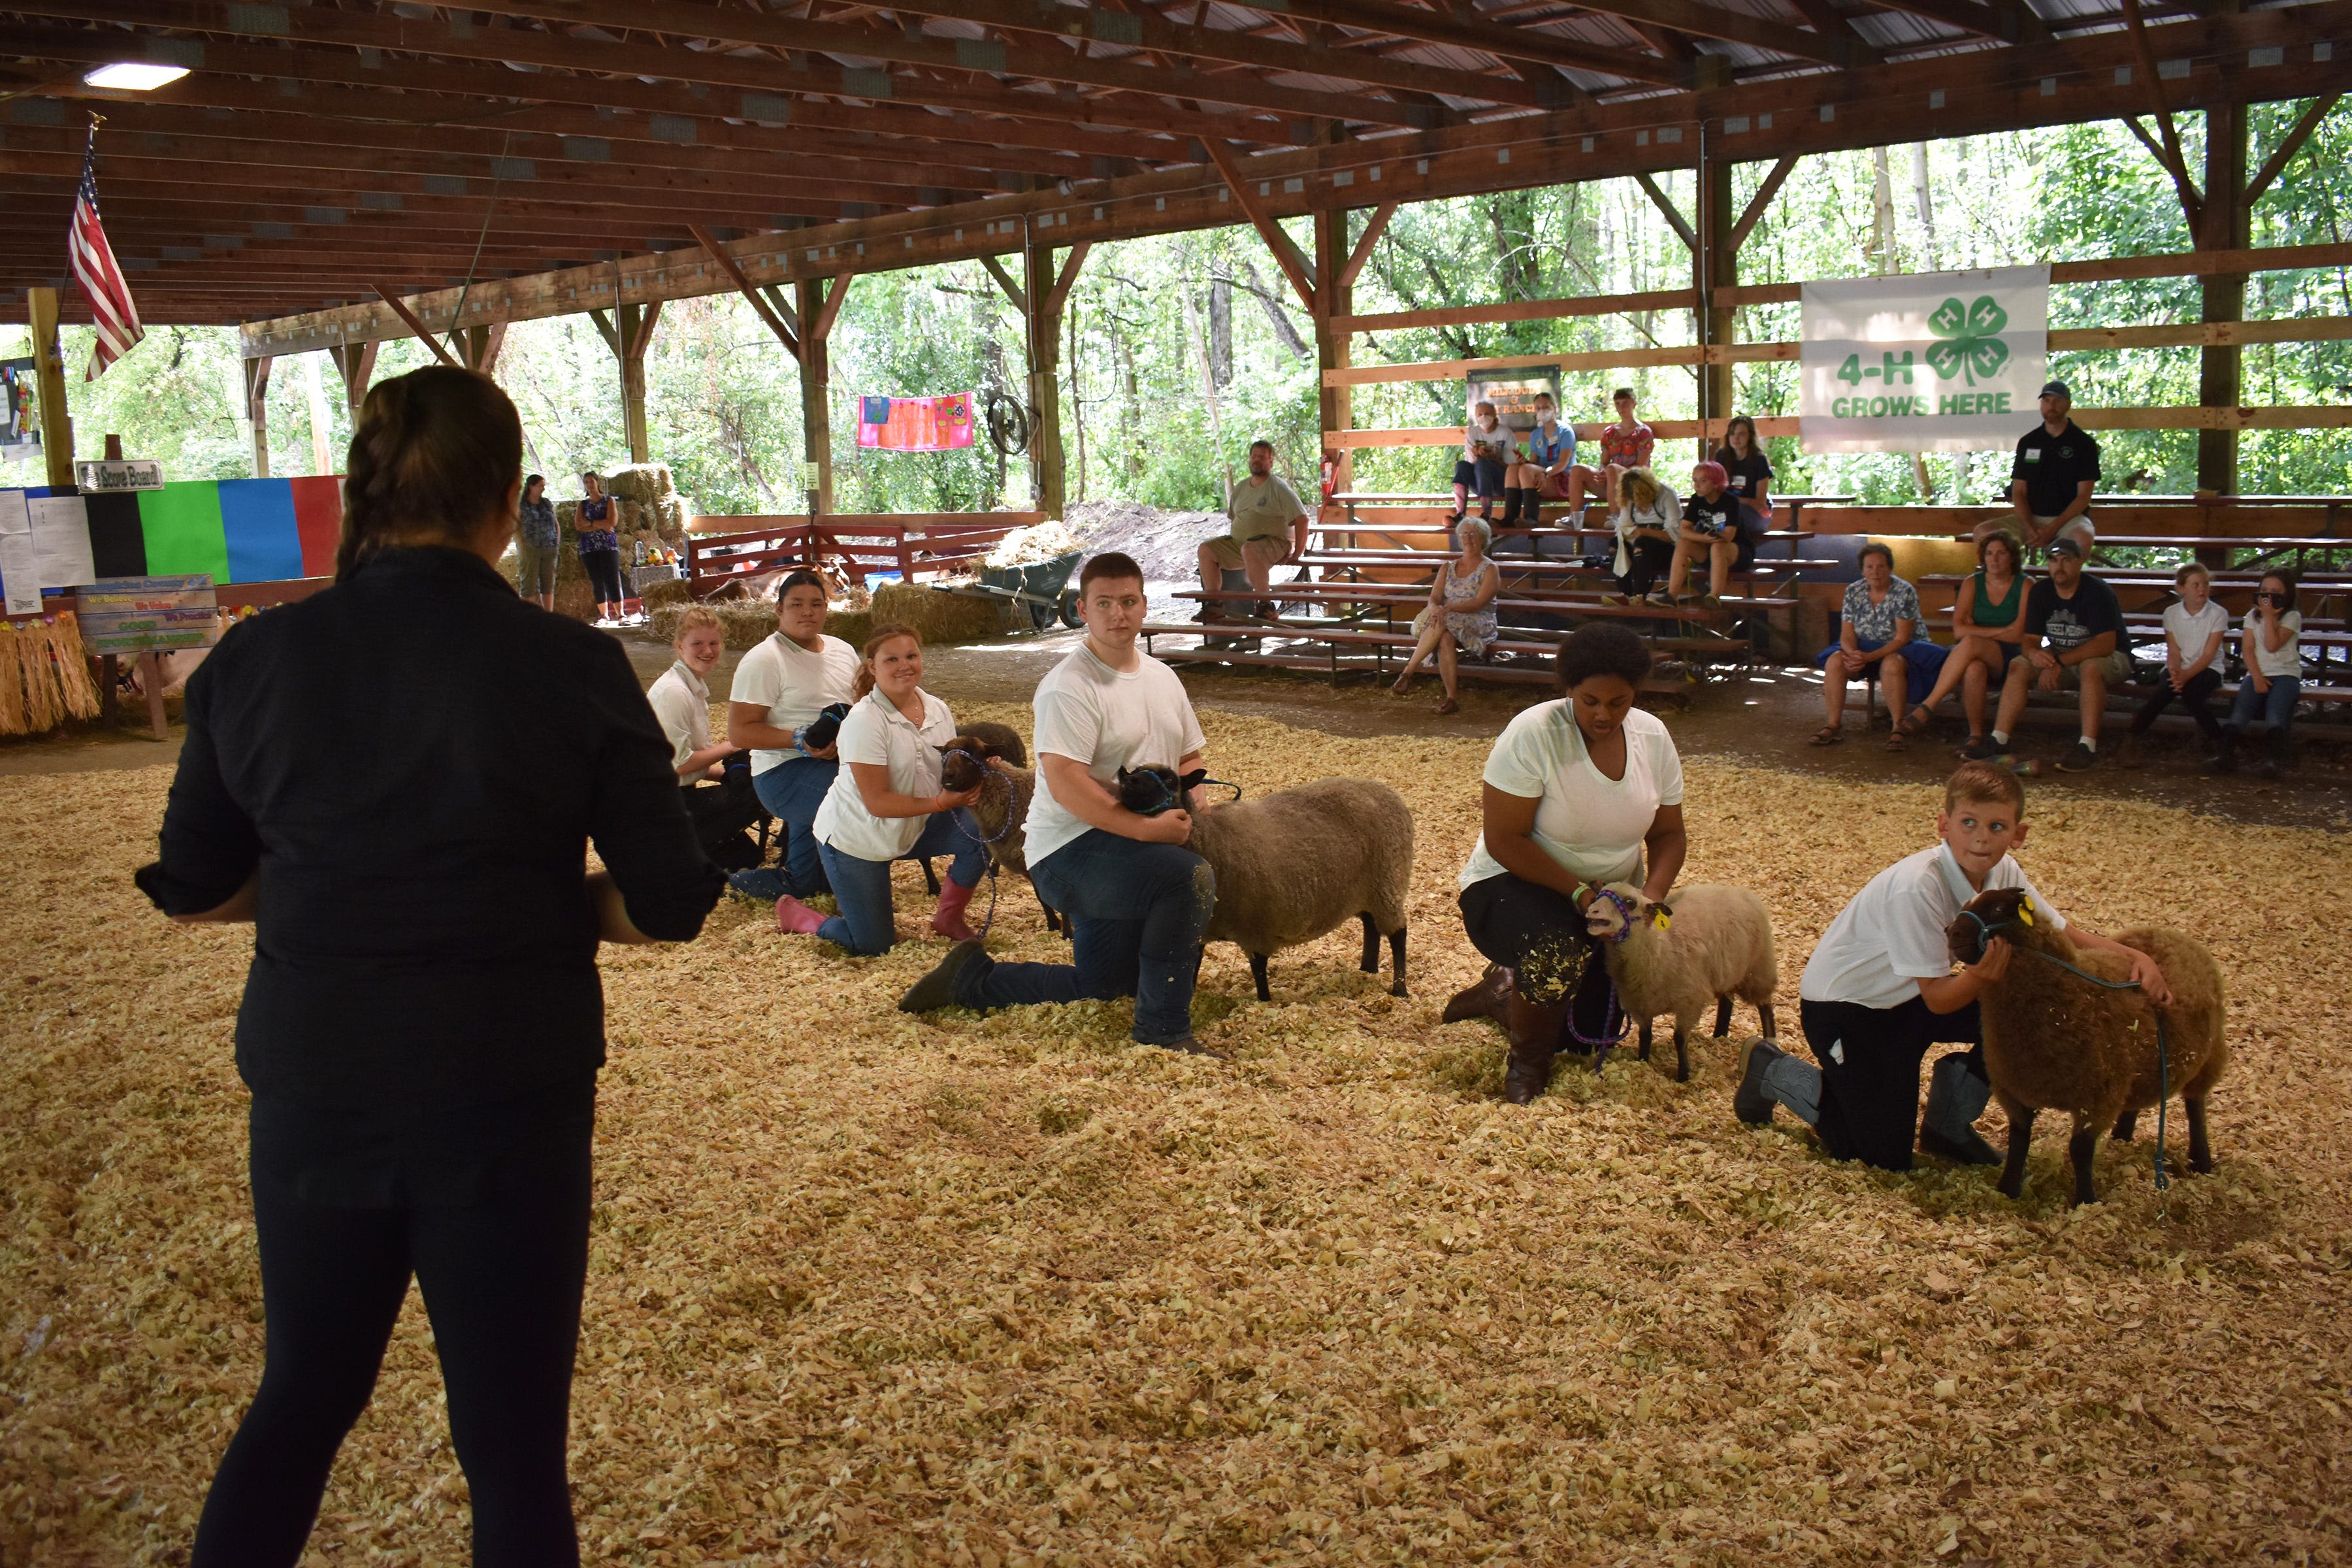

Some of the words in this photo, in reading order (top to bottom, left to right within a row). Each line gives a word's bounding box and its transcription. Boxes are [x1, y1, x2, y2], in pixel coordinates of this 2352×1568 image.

[1837, 350, 1913, 386] 4-H
[1487, 387, 1511, 397] MILK
[1832, 396, 1930, 418] GROWS
[1939, 392, 2012, 415] HERE
[88, 595, 103, 604] We
[104, 595, 133, 603] Believe
